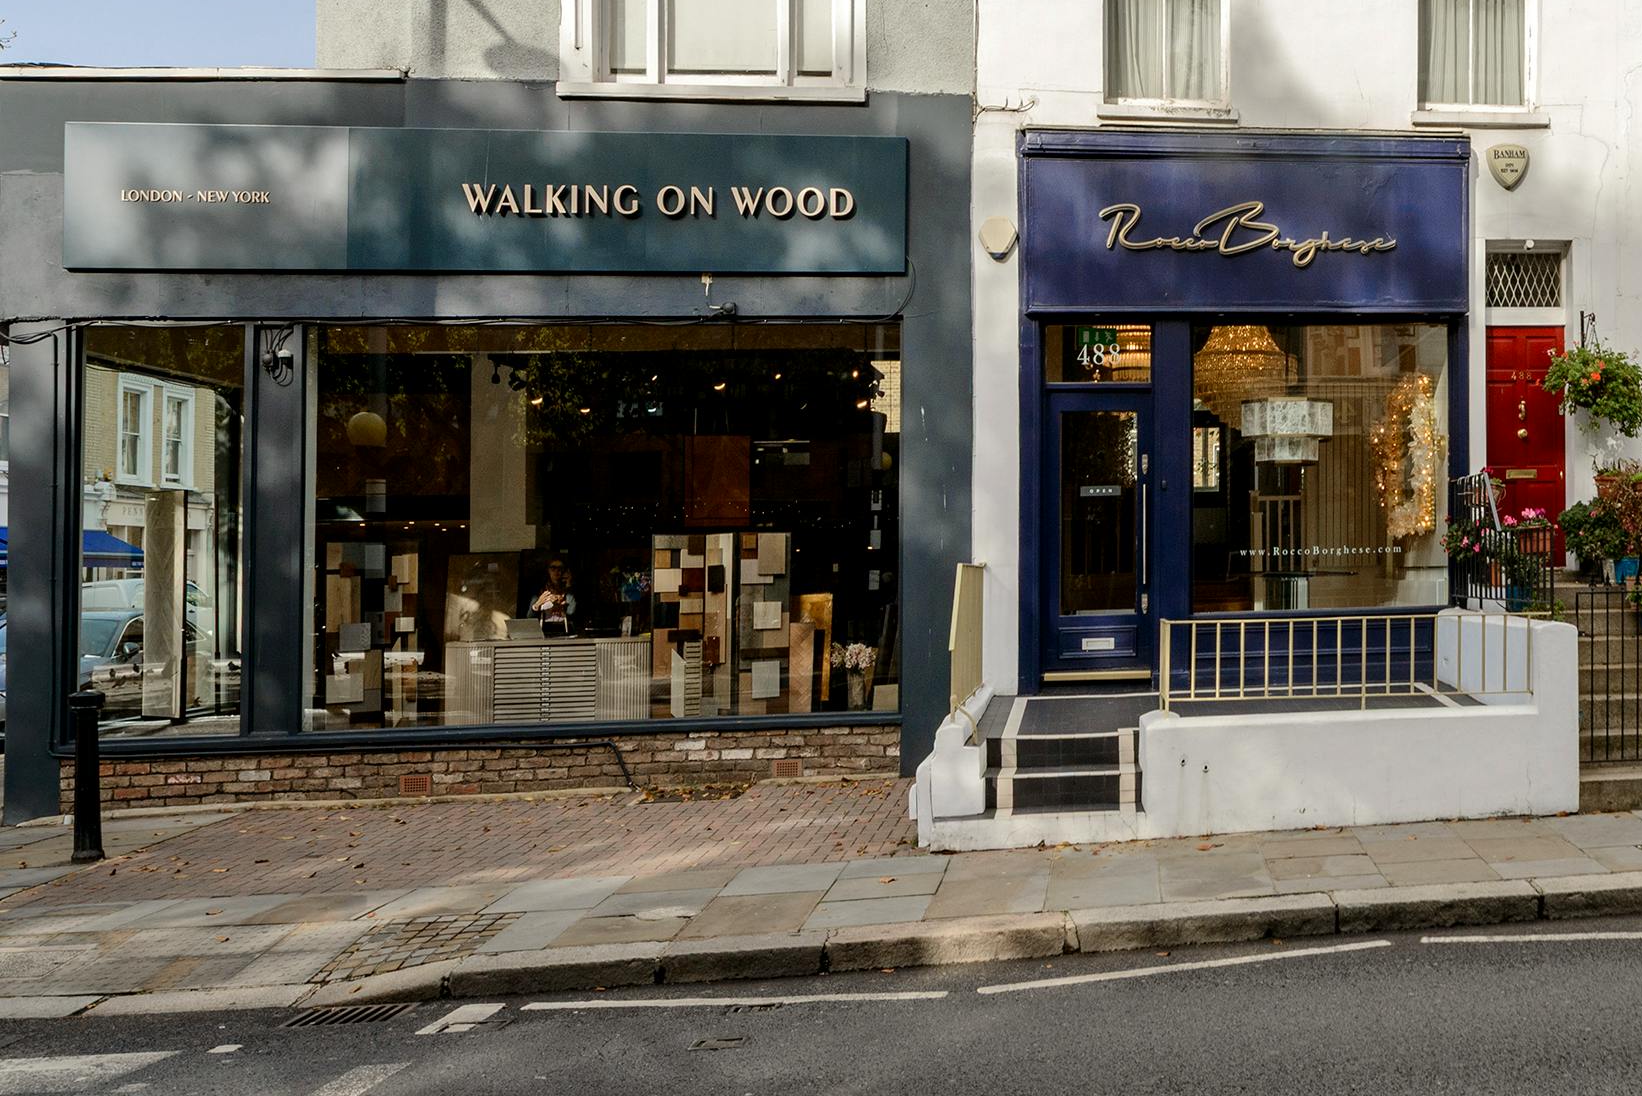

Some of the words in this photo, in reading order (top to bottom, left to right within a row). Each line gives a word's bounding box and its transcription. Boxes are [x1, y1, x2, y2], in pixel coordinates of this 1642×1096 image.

[1493, 149, 1526, 159] BANHAM
[121, 189, 183, 202] LONDON
[197, 190, 229, 202] NEW
[231, 190, 270, 203] YORK
[462, 183, 639, 216] WALKING
[656, 184, 714, 216] ON
[730, 186, 854, 217] WOOD
[1076, 343, 1121, 366] 488
[1511, 370, 1531, 381] 488
[1239, 545, 1402, 556] www.RoccoBorghese.com
